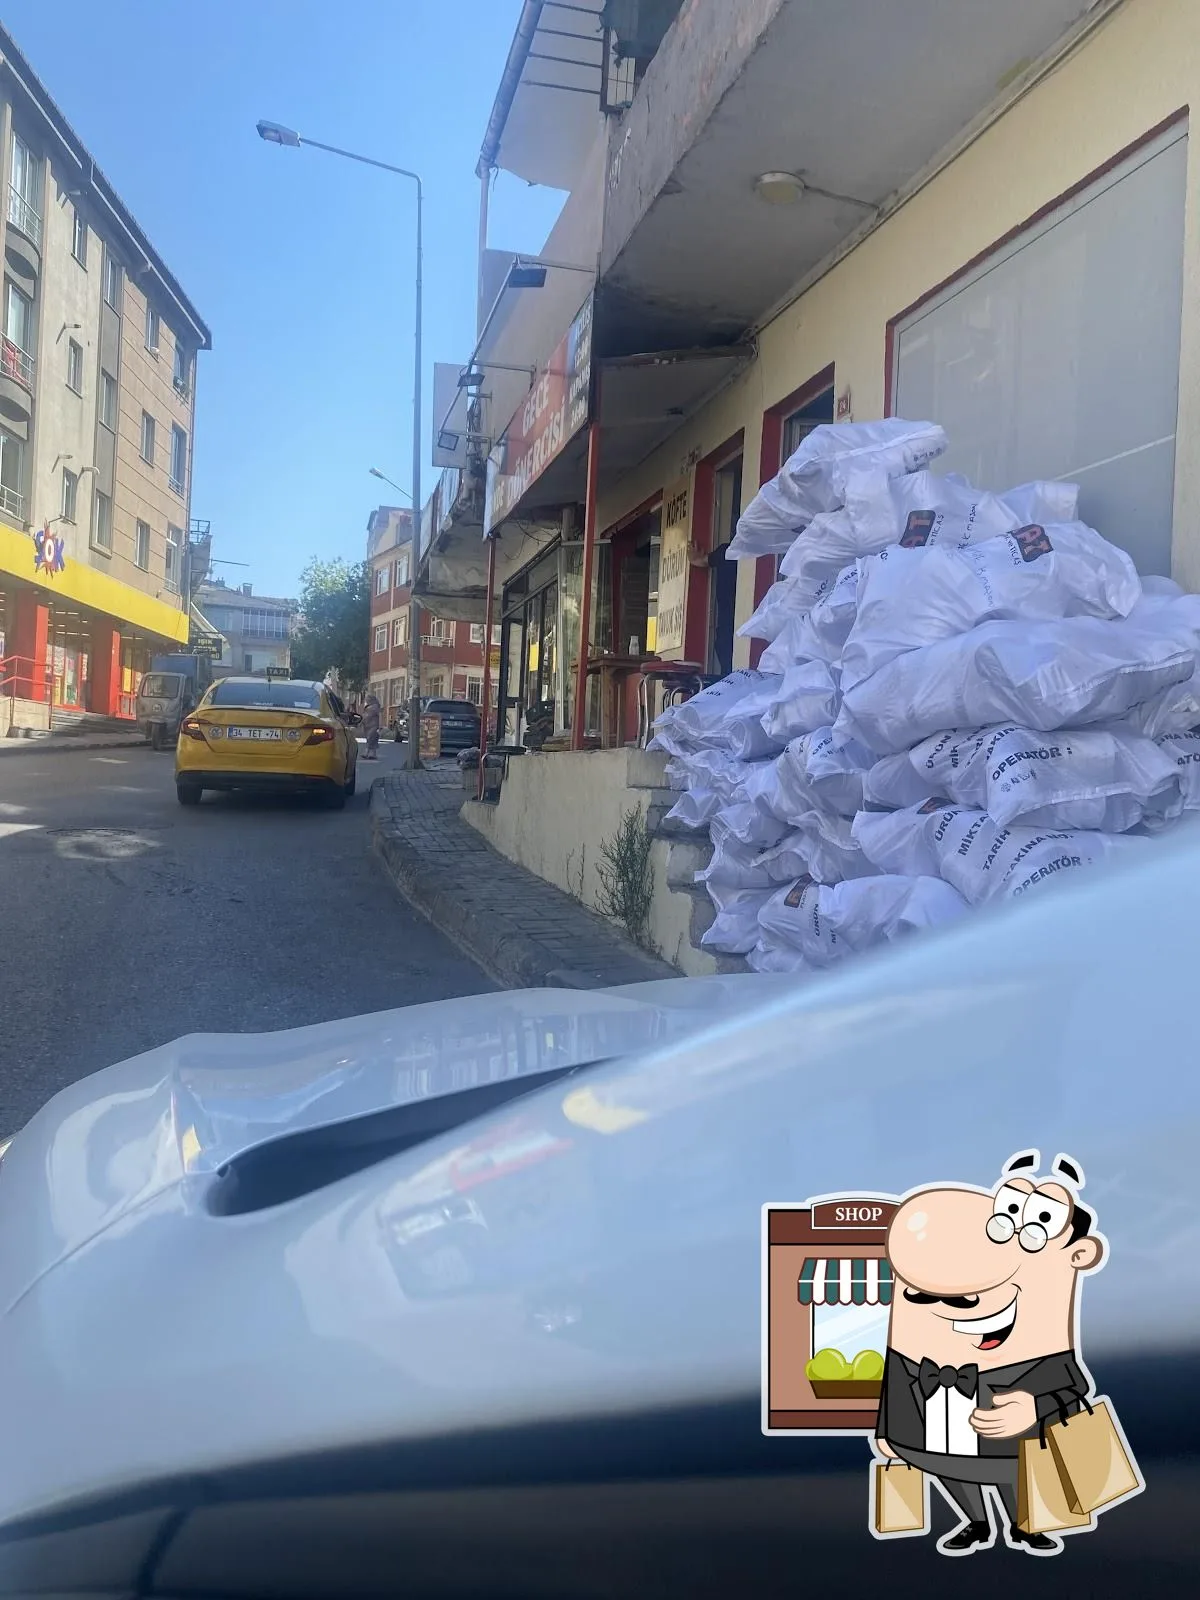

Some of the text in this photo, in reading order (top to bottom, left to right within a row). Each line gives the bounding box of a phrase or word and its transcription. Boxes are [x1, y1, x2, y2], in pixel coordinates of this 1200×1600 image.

[522, 371, 550, 437] GECE
[666, 490, 687, 529] KÖFTE
[662, 544, 685, 585] DÜRÜM
[233, 729, 279, 738] 34 TET 74
[983, 829, 1011, 871] TARİH
[1013, 855, 1082, 896] OPERATÖR
